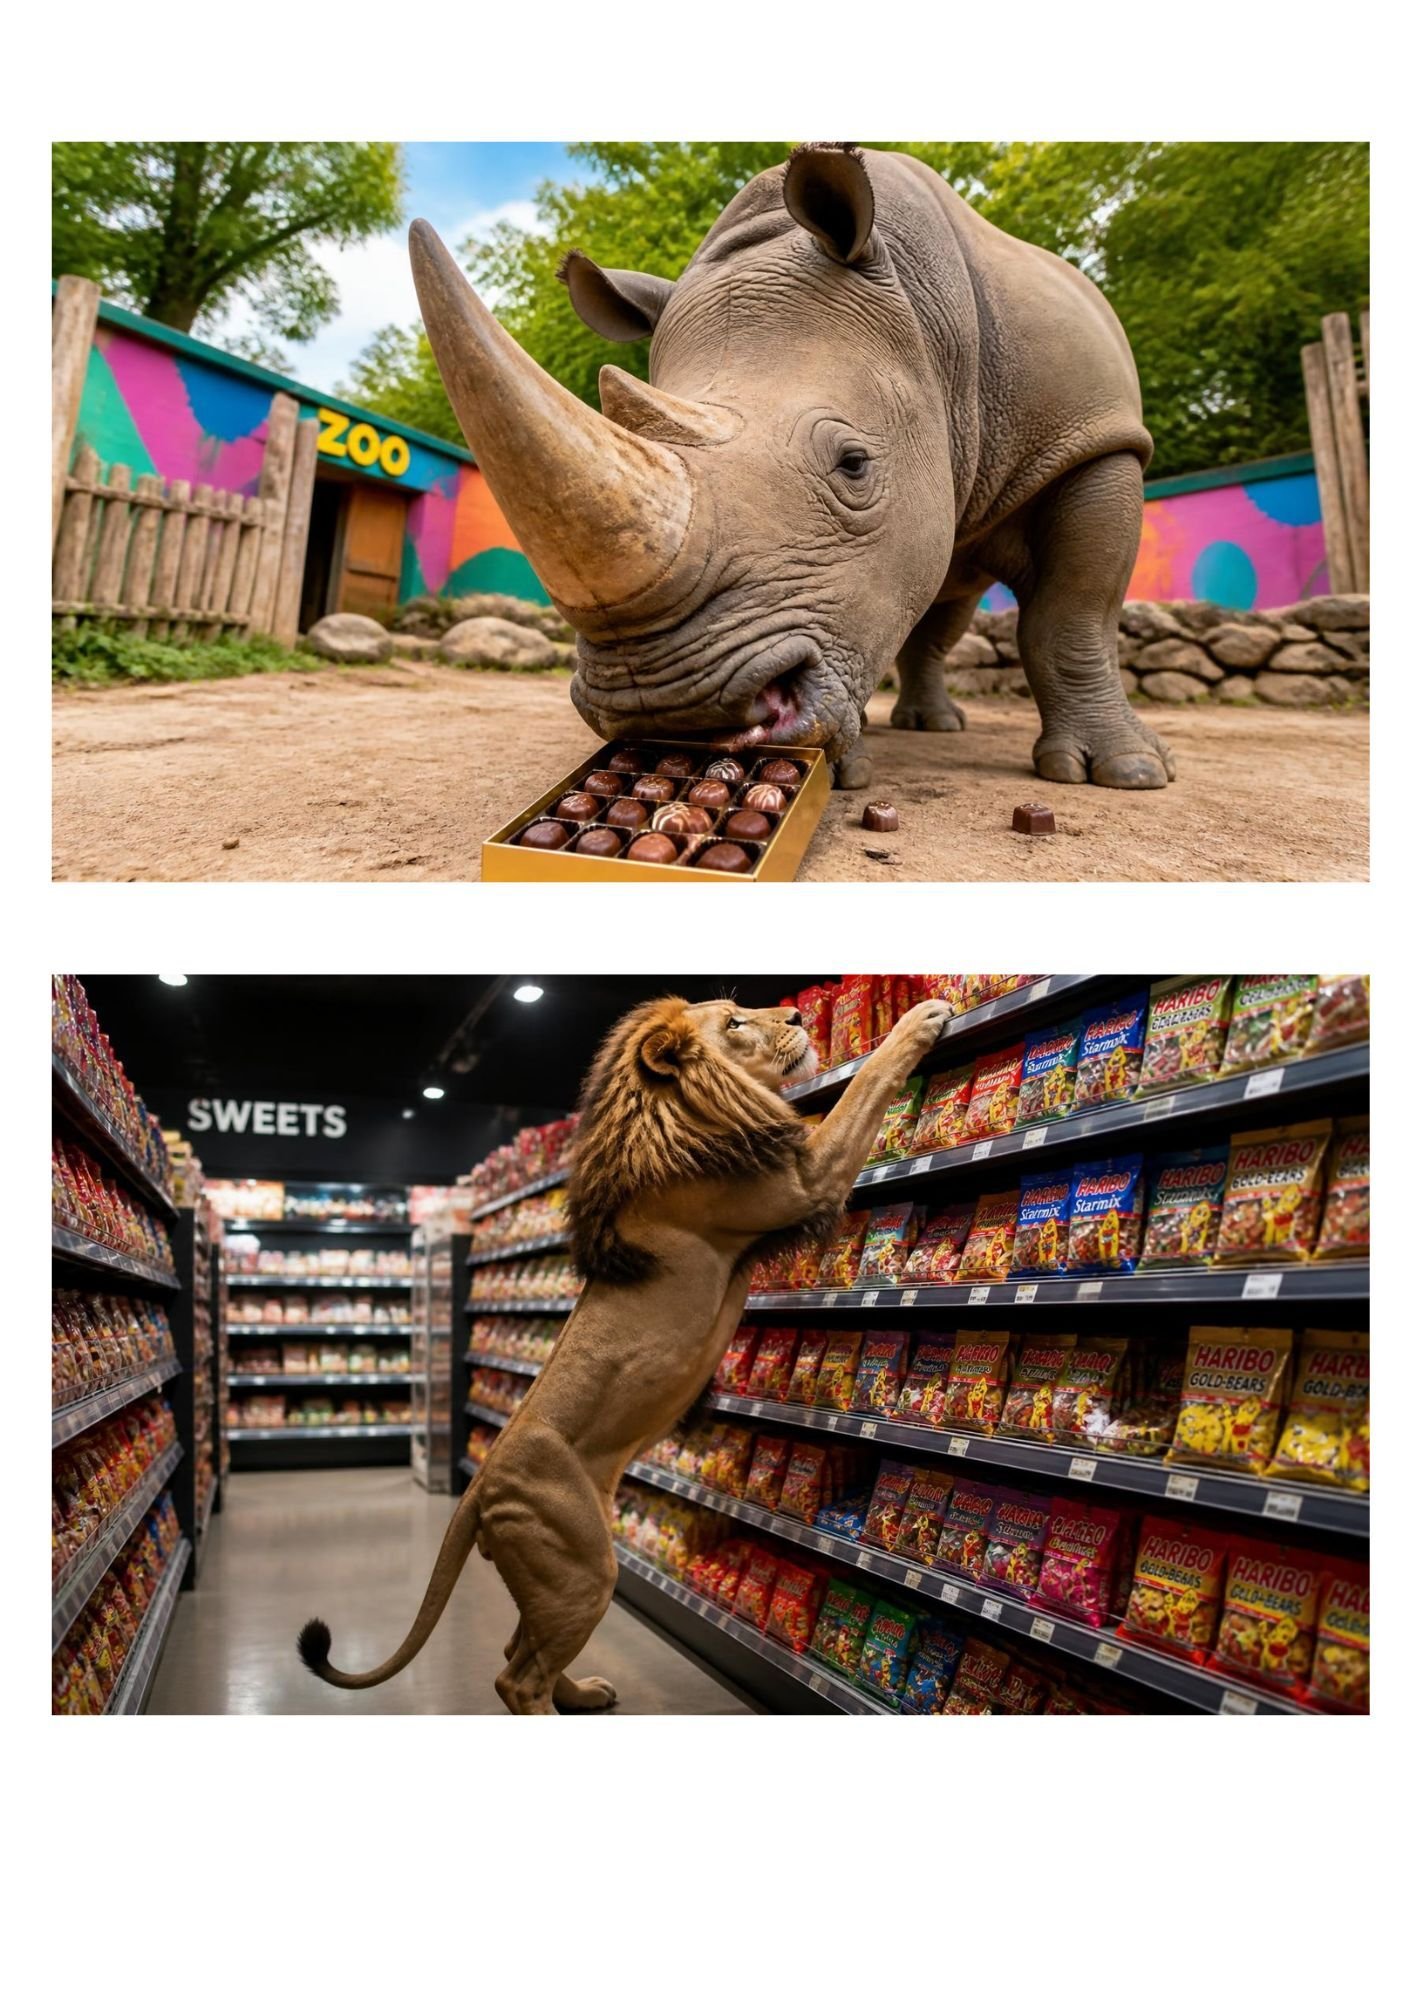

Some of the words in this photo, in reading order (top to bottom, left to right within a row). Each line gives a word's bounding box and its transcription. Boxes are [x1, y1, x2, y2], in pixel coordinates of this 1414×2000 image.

[316, 407, 411, 477] ZOO
[1151, 979, 1223, 1017] HARIBO
[187, 1098, 348, 1139] SWEETS
[1234, 1138, 1317, 1171] HARIBO
[1075, 1172, 1132, 1198] HARIBO
[1158, 1162, 1226, 1189] HARIBO
[1073, 1194, 1124, 1214] Starmix
[1193, 1343, 1275, 1375] HARIBO
[1189, 1371, 1265, 1393] GOLD-BEARS
[1142, 1535, 1215, 1573] HARIBO
[1231, 1557, 1314, 1600] HARIBO
